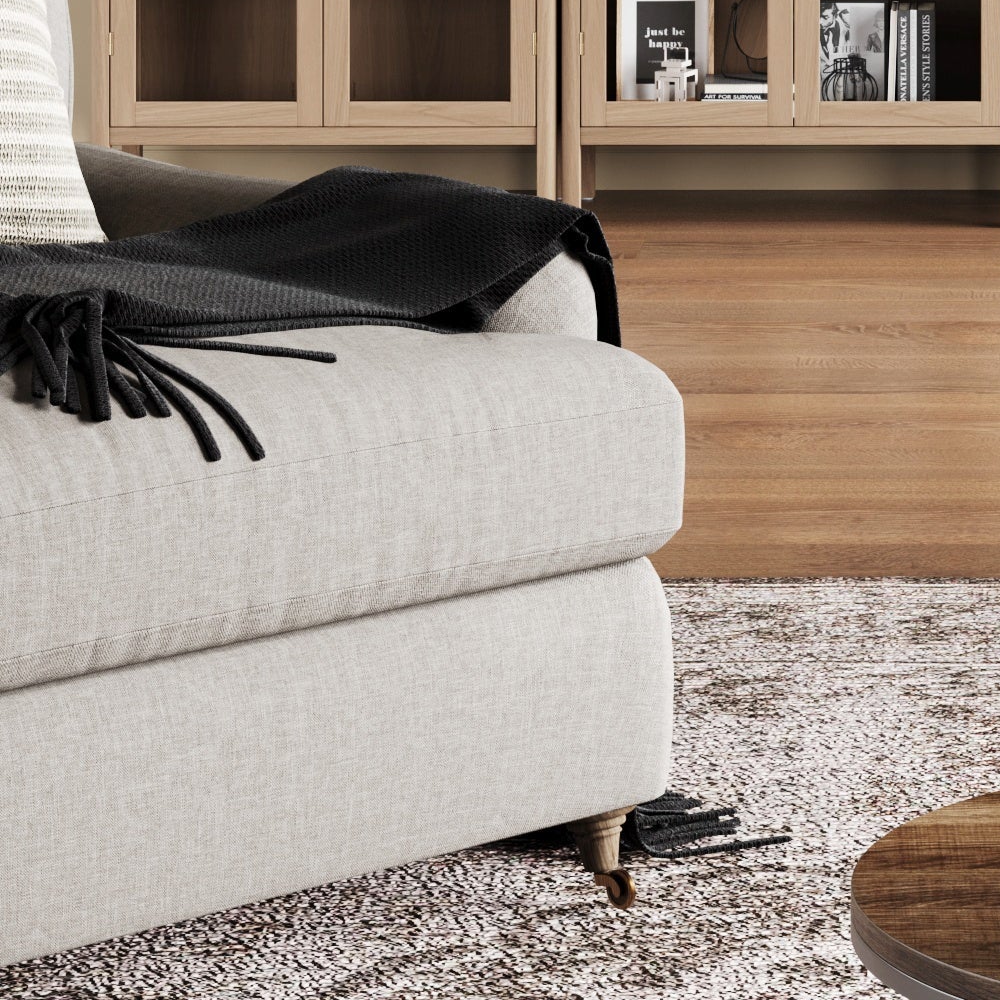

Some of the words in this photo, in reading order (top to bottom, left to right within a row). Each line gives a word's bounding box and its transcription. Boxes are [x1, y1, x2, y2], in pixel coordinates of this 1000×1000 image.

[644, 26, 669, 38] just
[672, 26, 685, 36] be
[648, 38, 683, 50] happy
[900, 15, 908, 57] VERSACE
[922, 14, 931, 53] STORIES
[922, 53, 931, 82] STYLE
